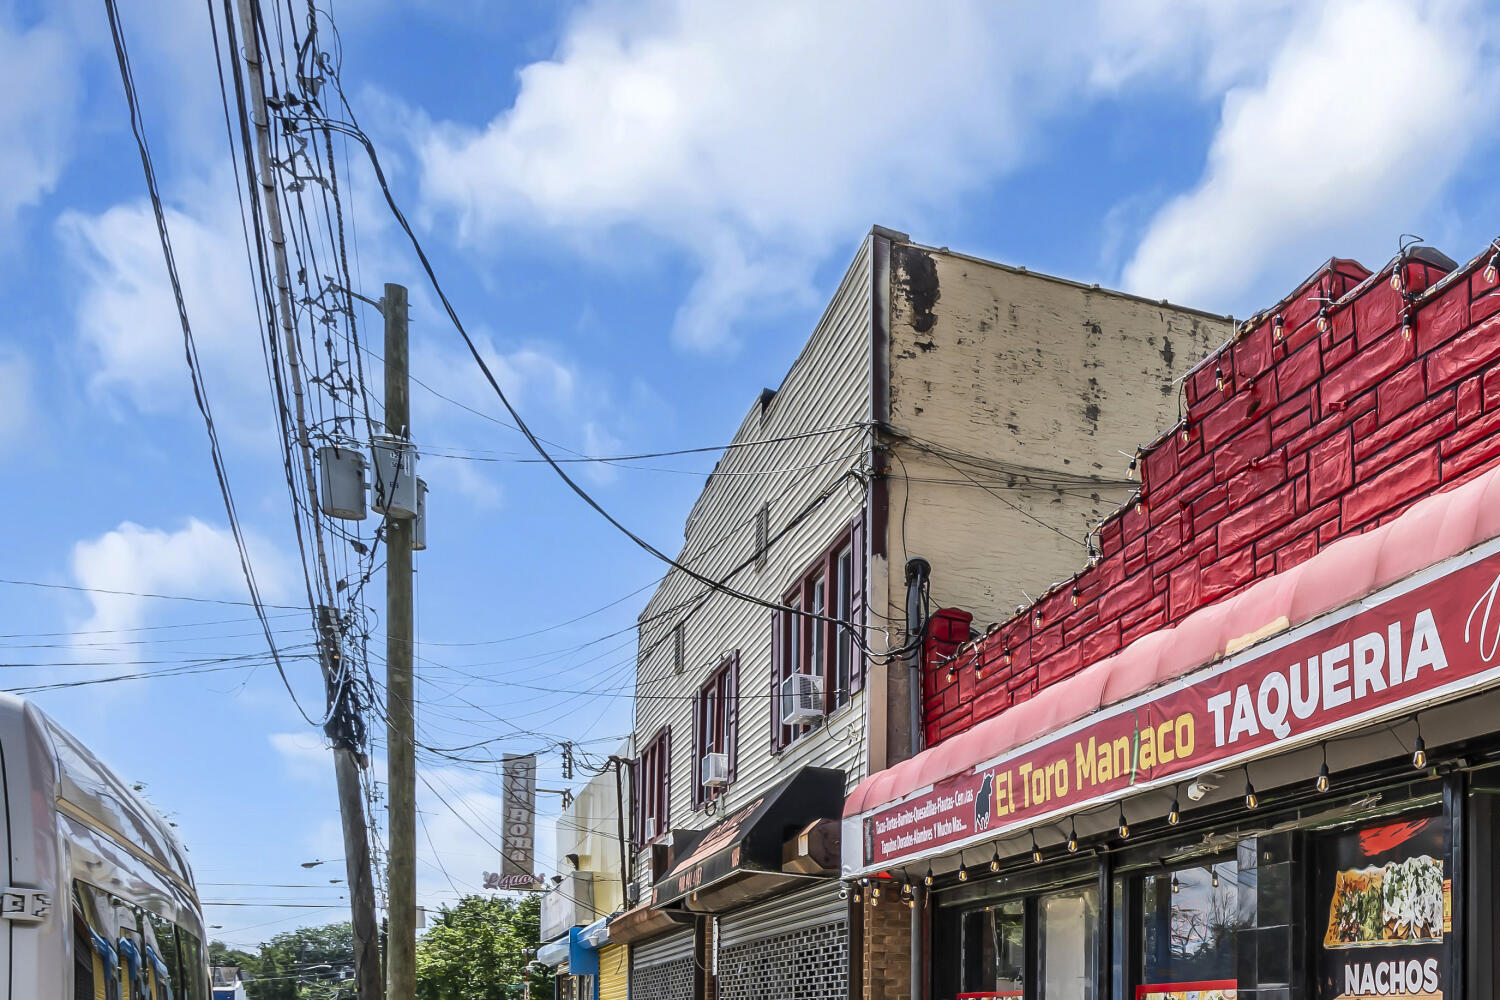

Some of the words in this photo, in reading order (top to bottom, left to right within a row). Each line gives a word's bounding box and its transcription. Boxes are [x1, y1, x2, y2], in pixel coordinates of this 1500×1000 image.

[996, 771, 1015, 817] El
[1019, 759, 1068, 808] Toro
[1207, 608, 1449, 748] TAQUERIA
[937, 819, 952, 837] Mucho
[1344, 959, 1439, 996] NACHOS
